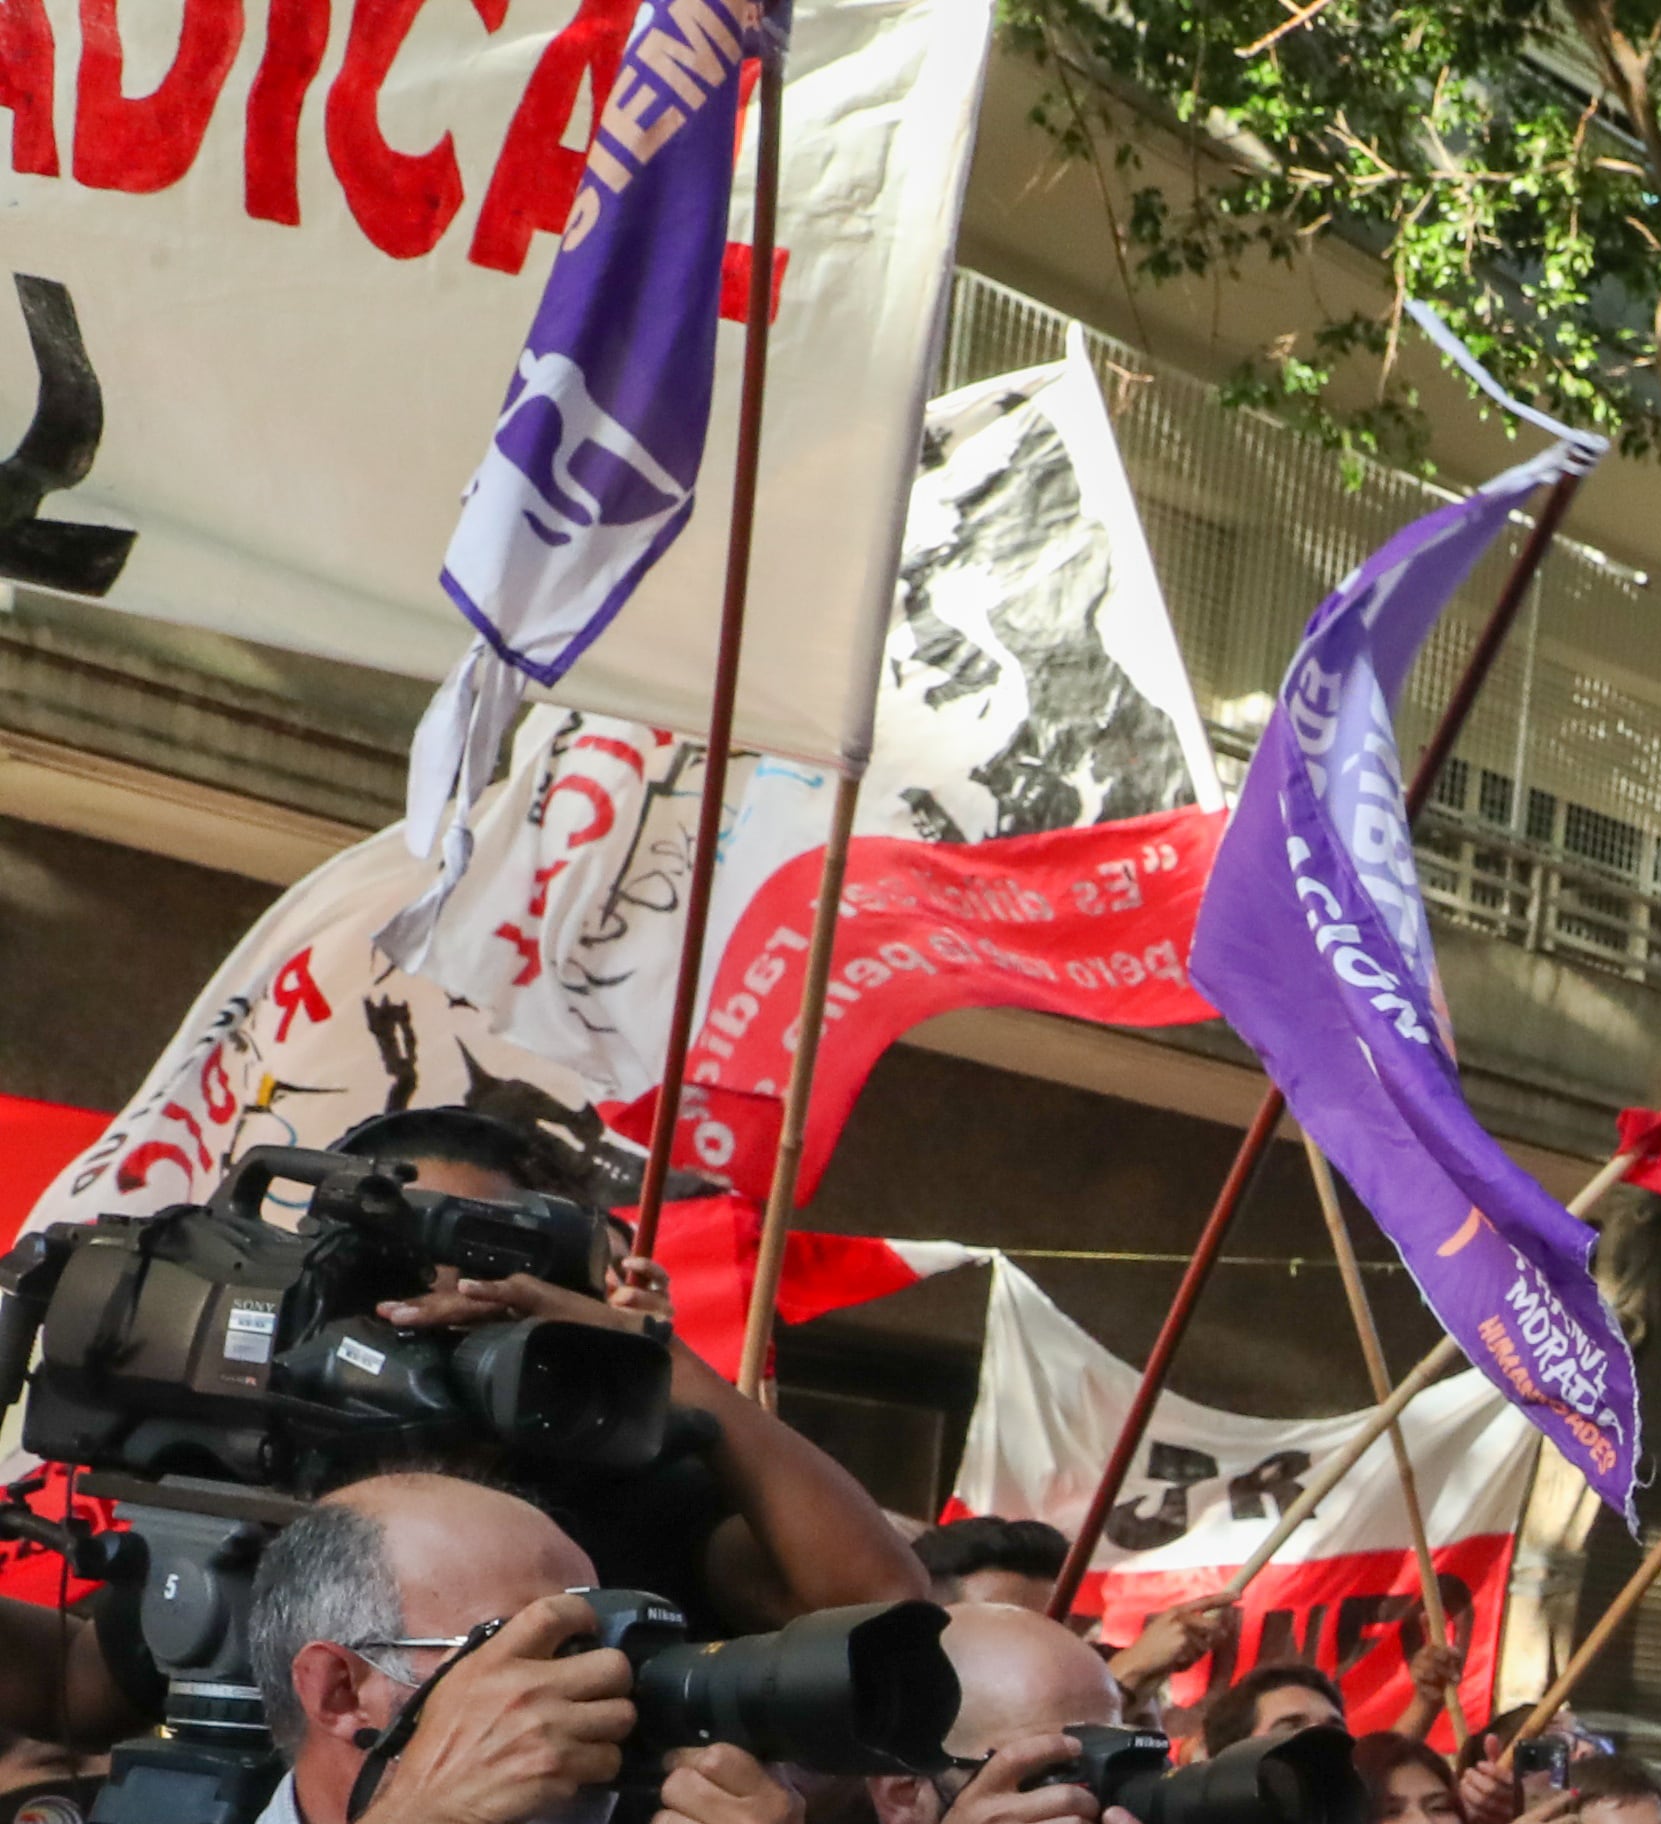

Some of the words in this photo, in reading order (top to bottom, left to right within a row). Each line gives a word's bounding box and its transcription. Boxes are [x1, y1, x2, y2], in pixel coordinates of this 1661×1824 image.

[233, 1298, 276, 1313] SONY
[163, 1574, 179, 1601] 5
[646, 1607, 686, 1625] Nikon
[1134, 1735, 1170, 1750] Nikon
